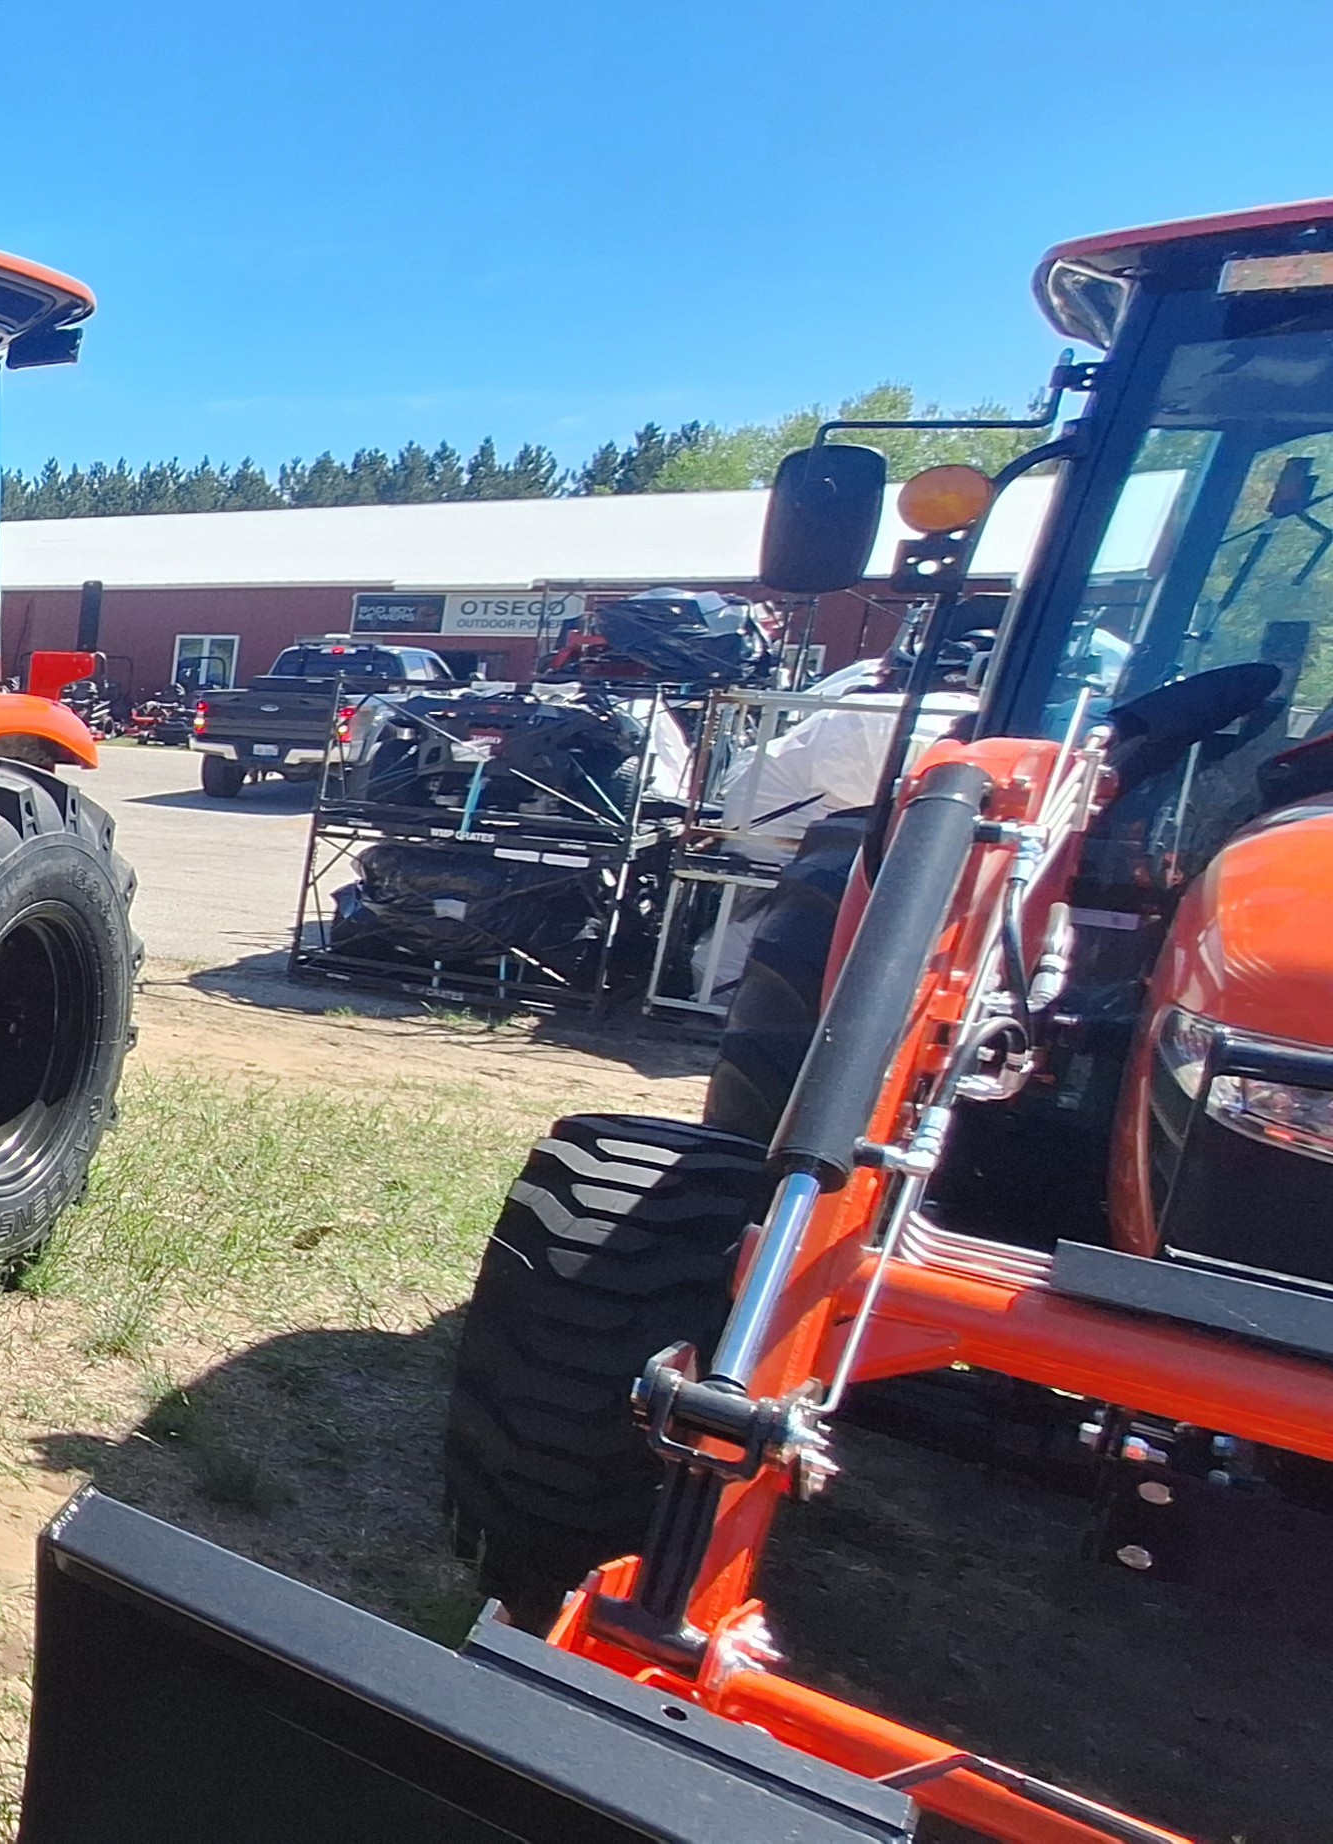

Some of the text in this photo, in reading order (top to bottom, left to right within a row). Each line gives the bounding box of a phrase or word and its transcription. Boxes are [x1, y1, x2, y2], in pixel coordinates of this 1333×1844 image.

[388, 606, 415, 615] BOY
[460, 599, 566, 616] OTSEGO
[456, 618, 516, 629] OUTDOOR
